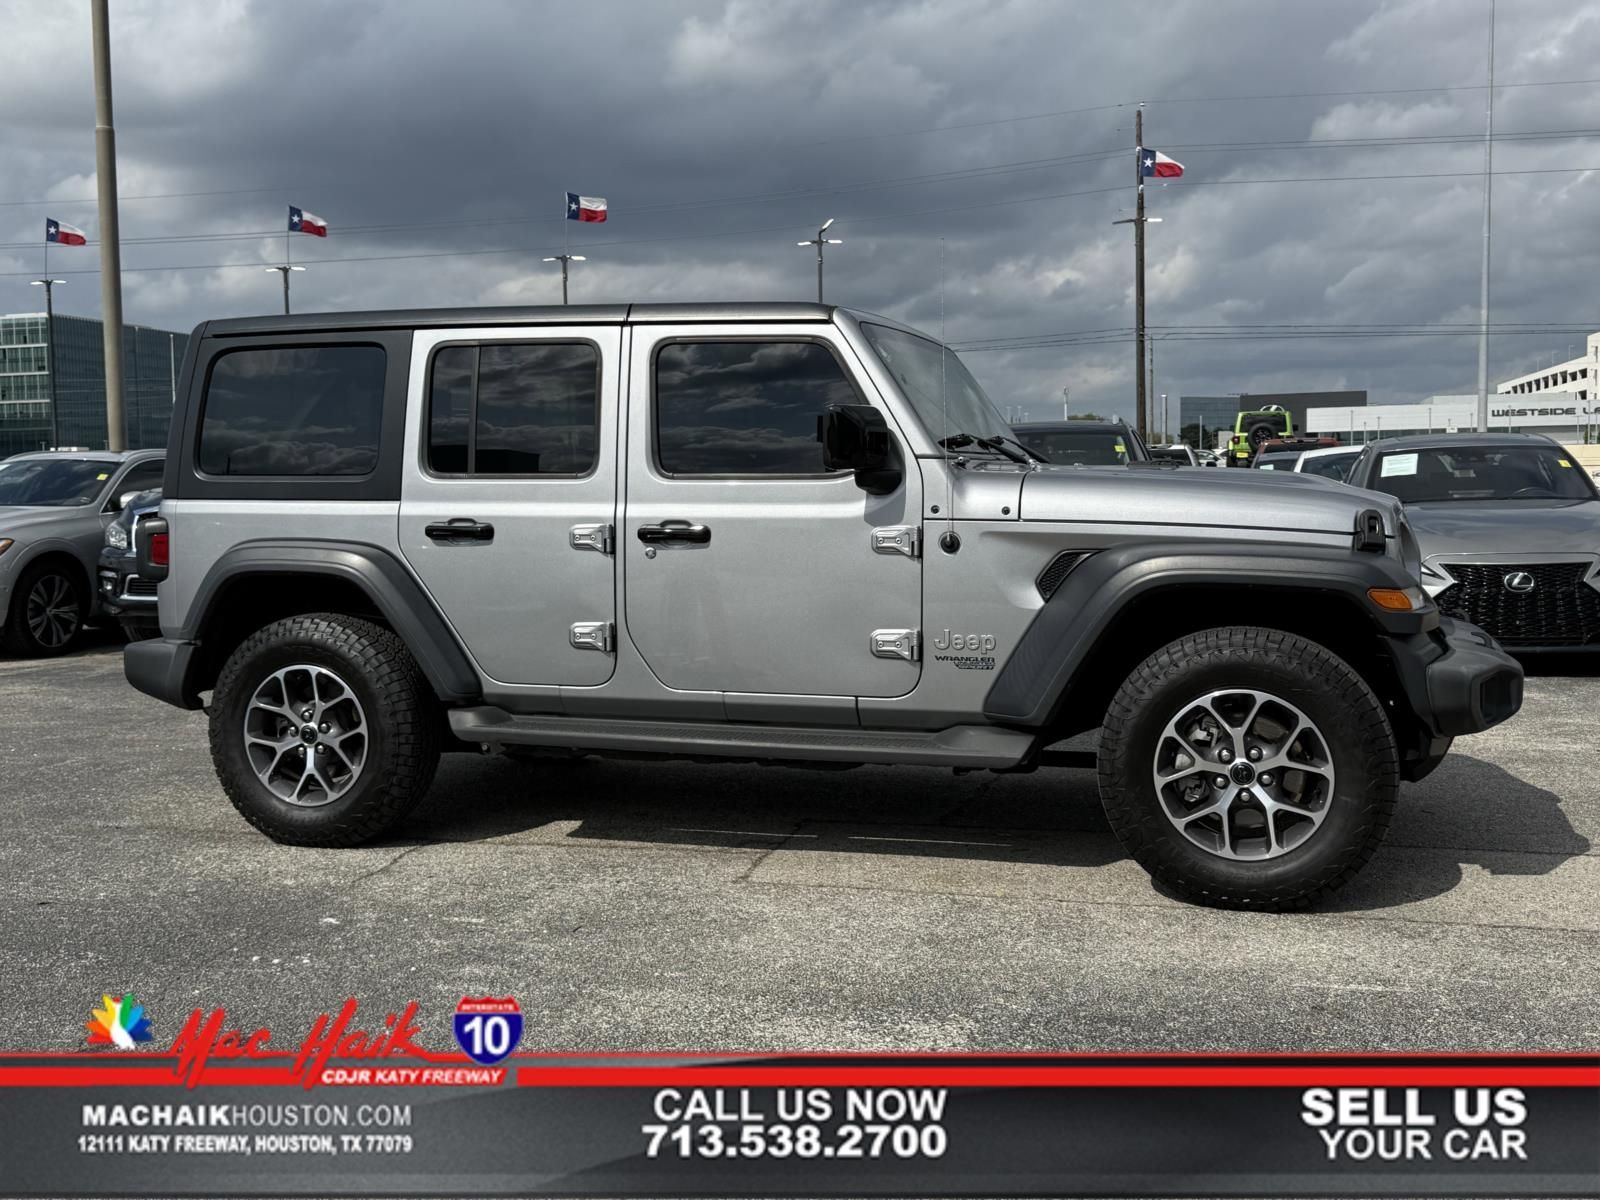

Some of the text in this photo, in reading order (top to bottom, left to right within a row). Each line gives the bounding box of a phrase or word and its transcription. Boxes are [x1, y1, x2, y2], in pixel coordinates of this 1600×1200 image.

[1491, 407, 1577, 417] WESTSIDE
[934, 628, 997, 655] Jeep
[934, 655, 995, 663] WRANGLER
